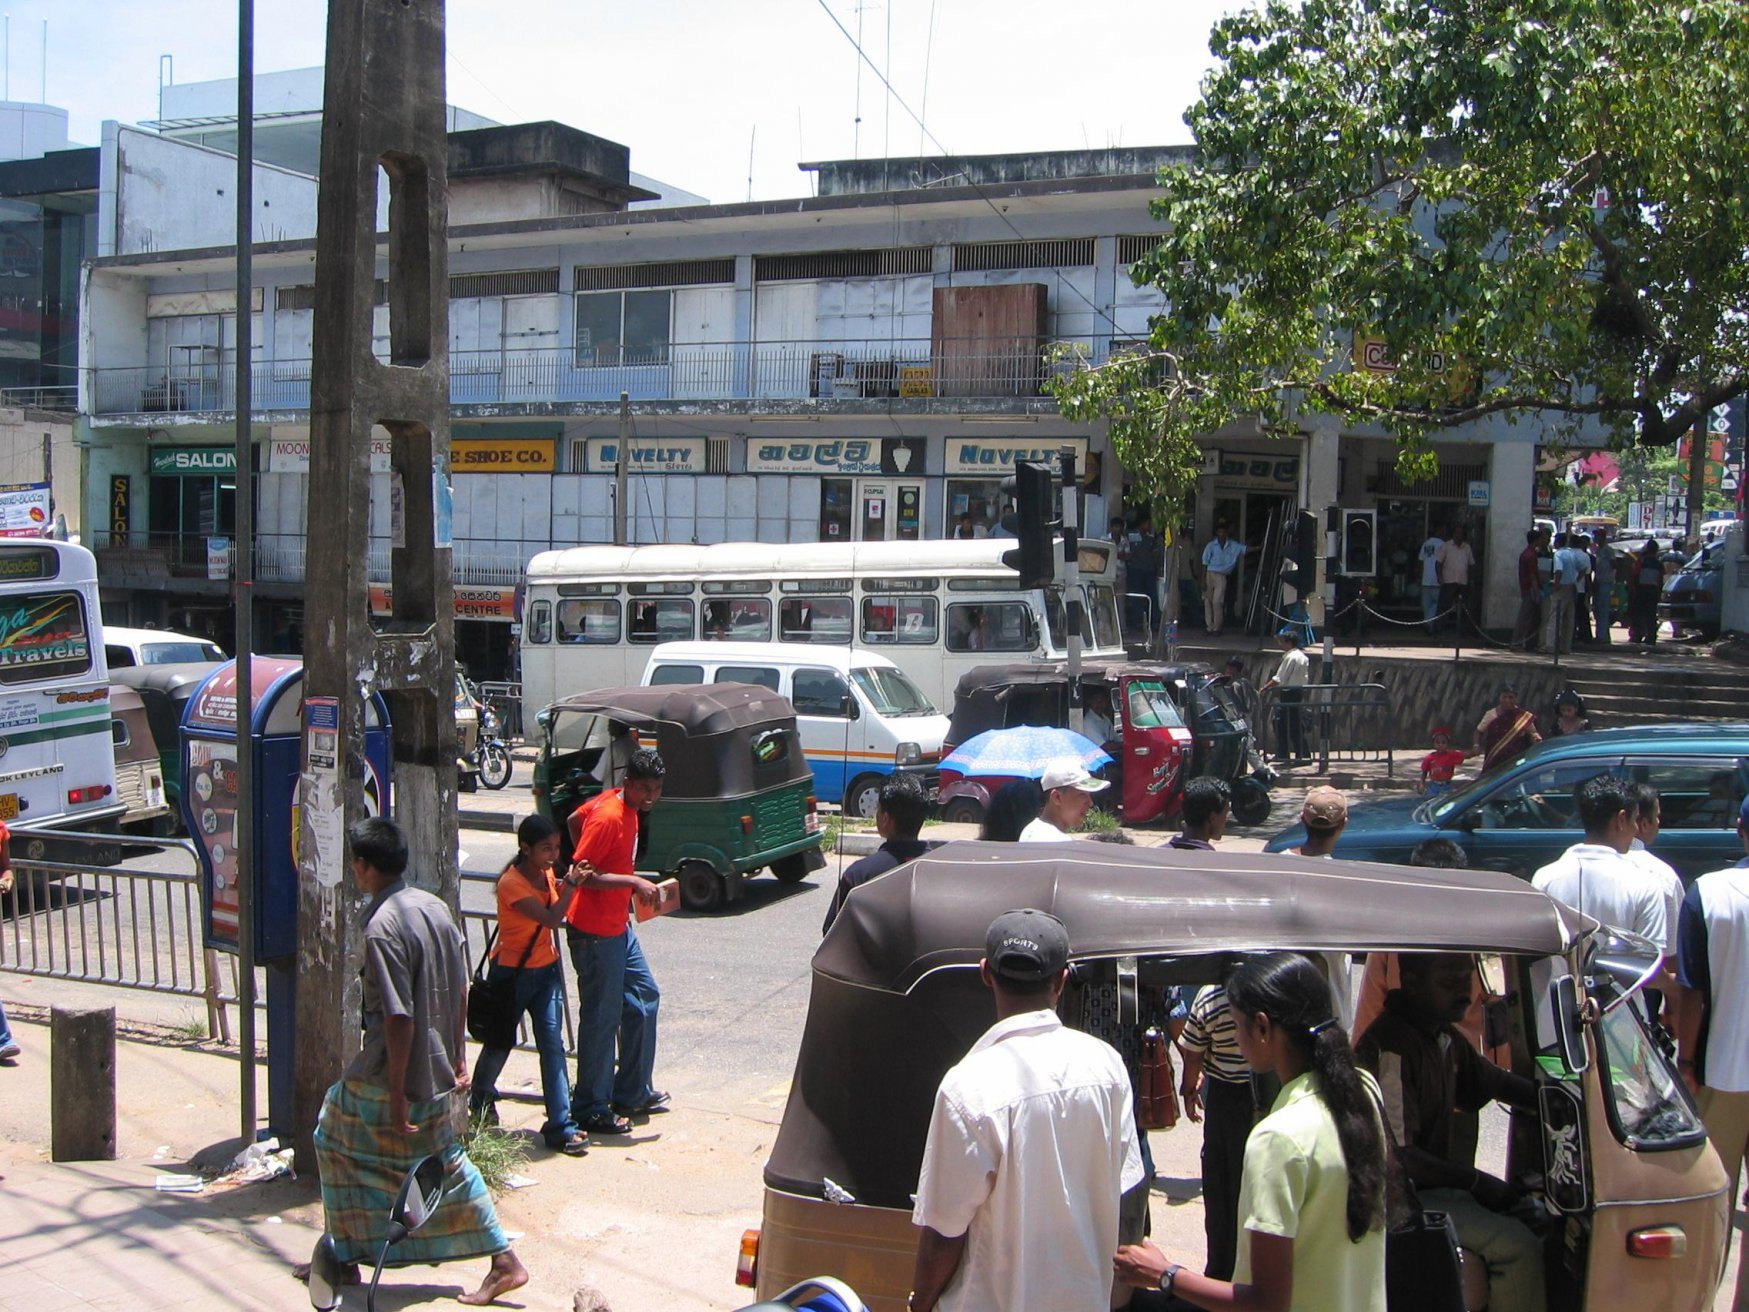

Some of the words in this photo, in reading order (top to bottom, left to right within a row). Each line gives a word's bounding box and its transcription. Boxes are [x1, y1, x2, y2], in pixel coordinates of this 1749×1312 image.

[176, 453, 237, 468] SALON
[464, 450, 513, 464] SHOE
[516, 450, 547, 463] CO.
[959, 444, 1062, 464] NOVELT
[114, 479, 127, 547] SALON
[455, 605, 501, 615] CENTRE
[0, 639, 87, 665] Travels
[15, 766, 64, 780] LEYLAND
[1003, 937, 1039, 951] SPORTS
